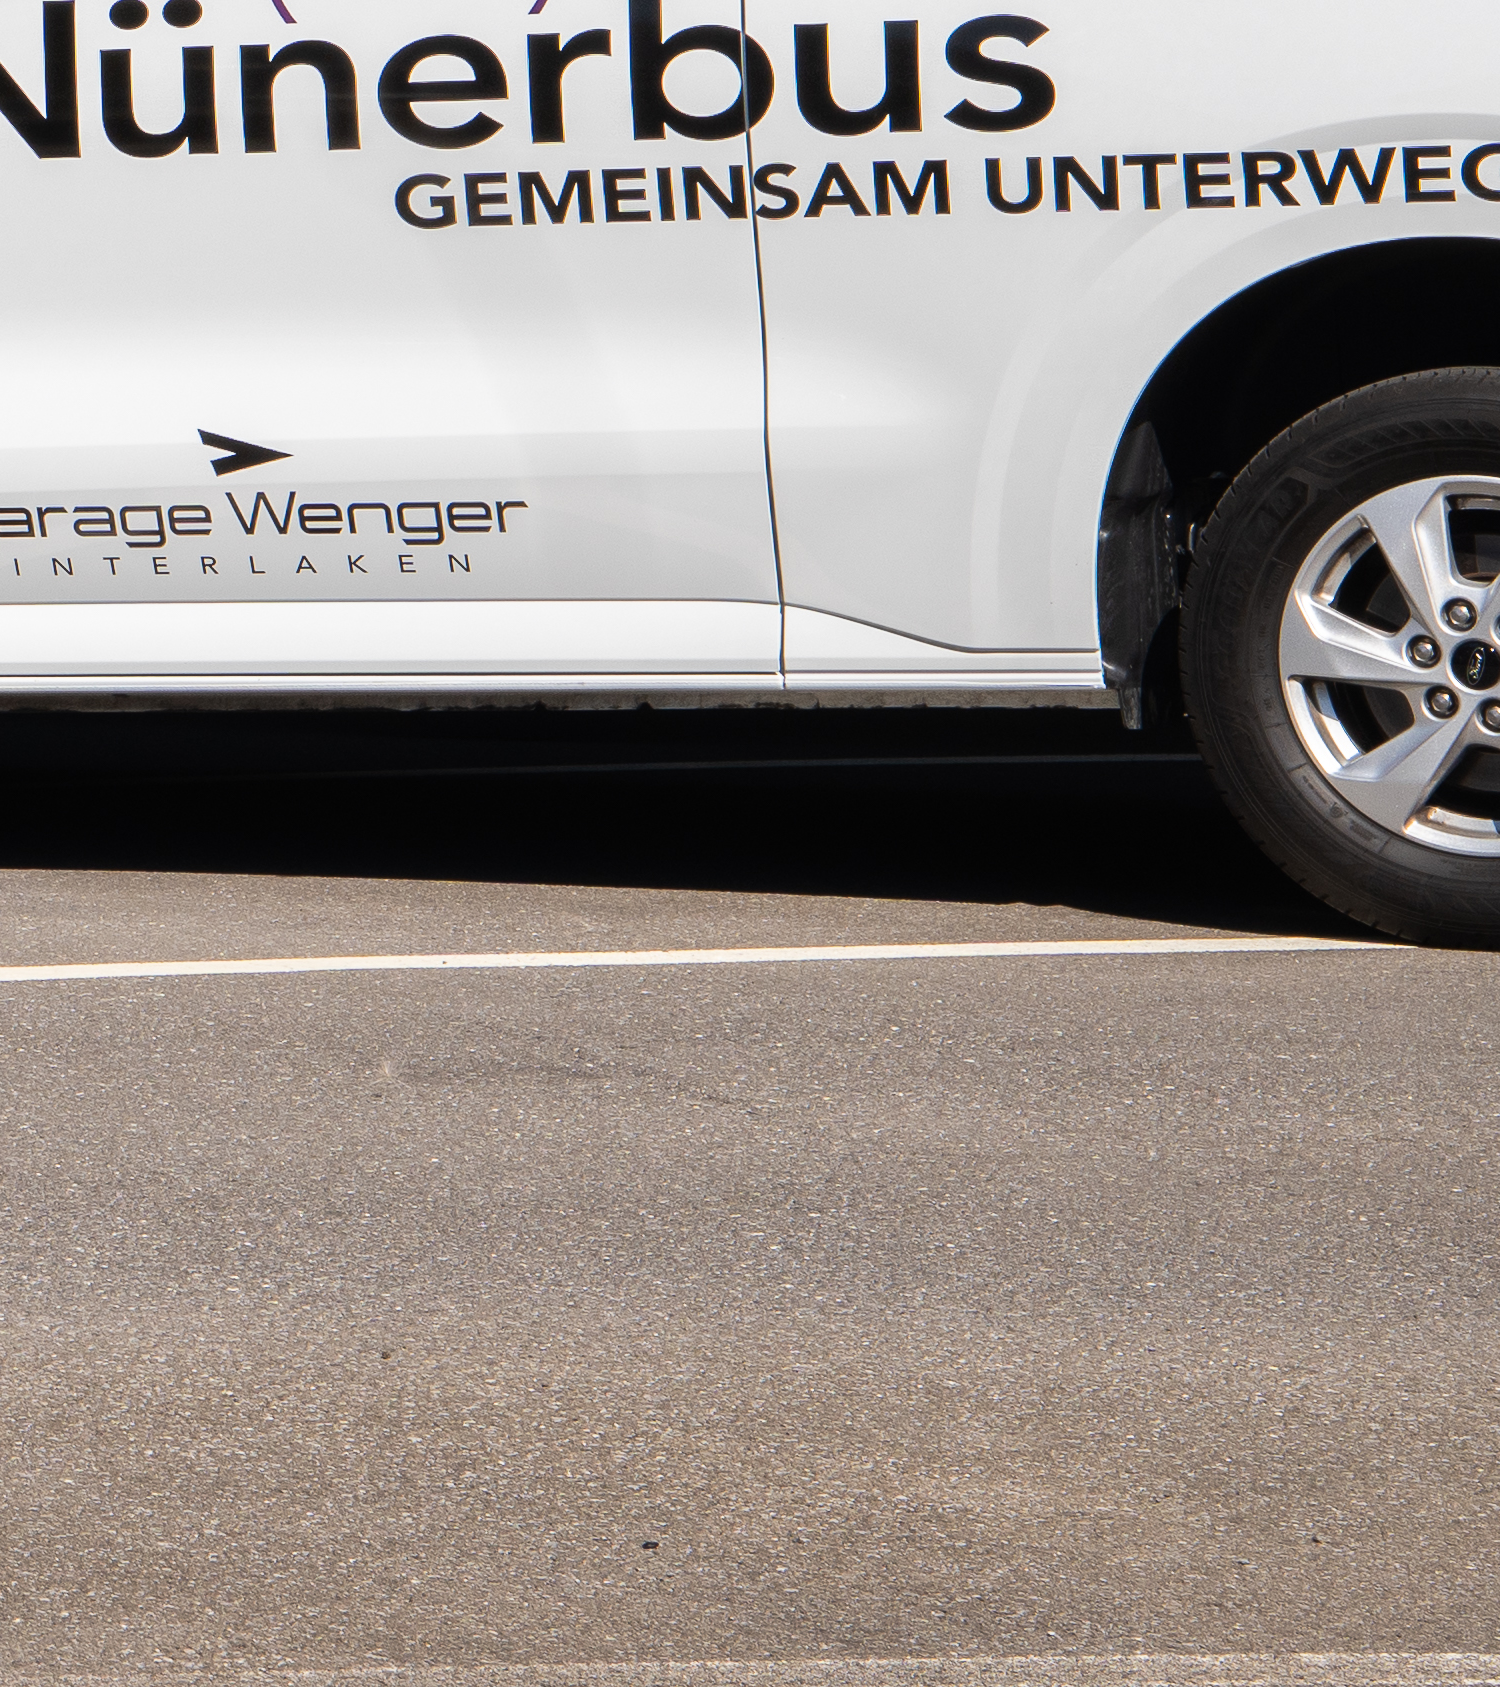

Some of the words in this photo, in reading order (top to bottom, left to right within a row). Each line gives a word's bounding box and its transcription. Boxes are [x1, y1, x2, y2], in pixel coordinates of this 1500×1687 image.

[393, 159, 952, 230] GEMEINSAM
[224, 490, 529, 546] Wenger
[13, 553, 472, 577] INTERLAKEN
